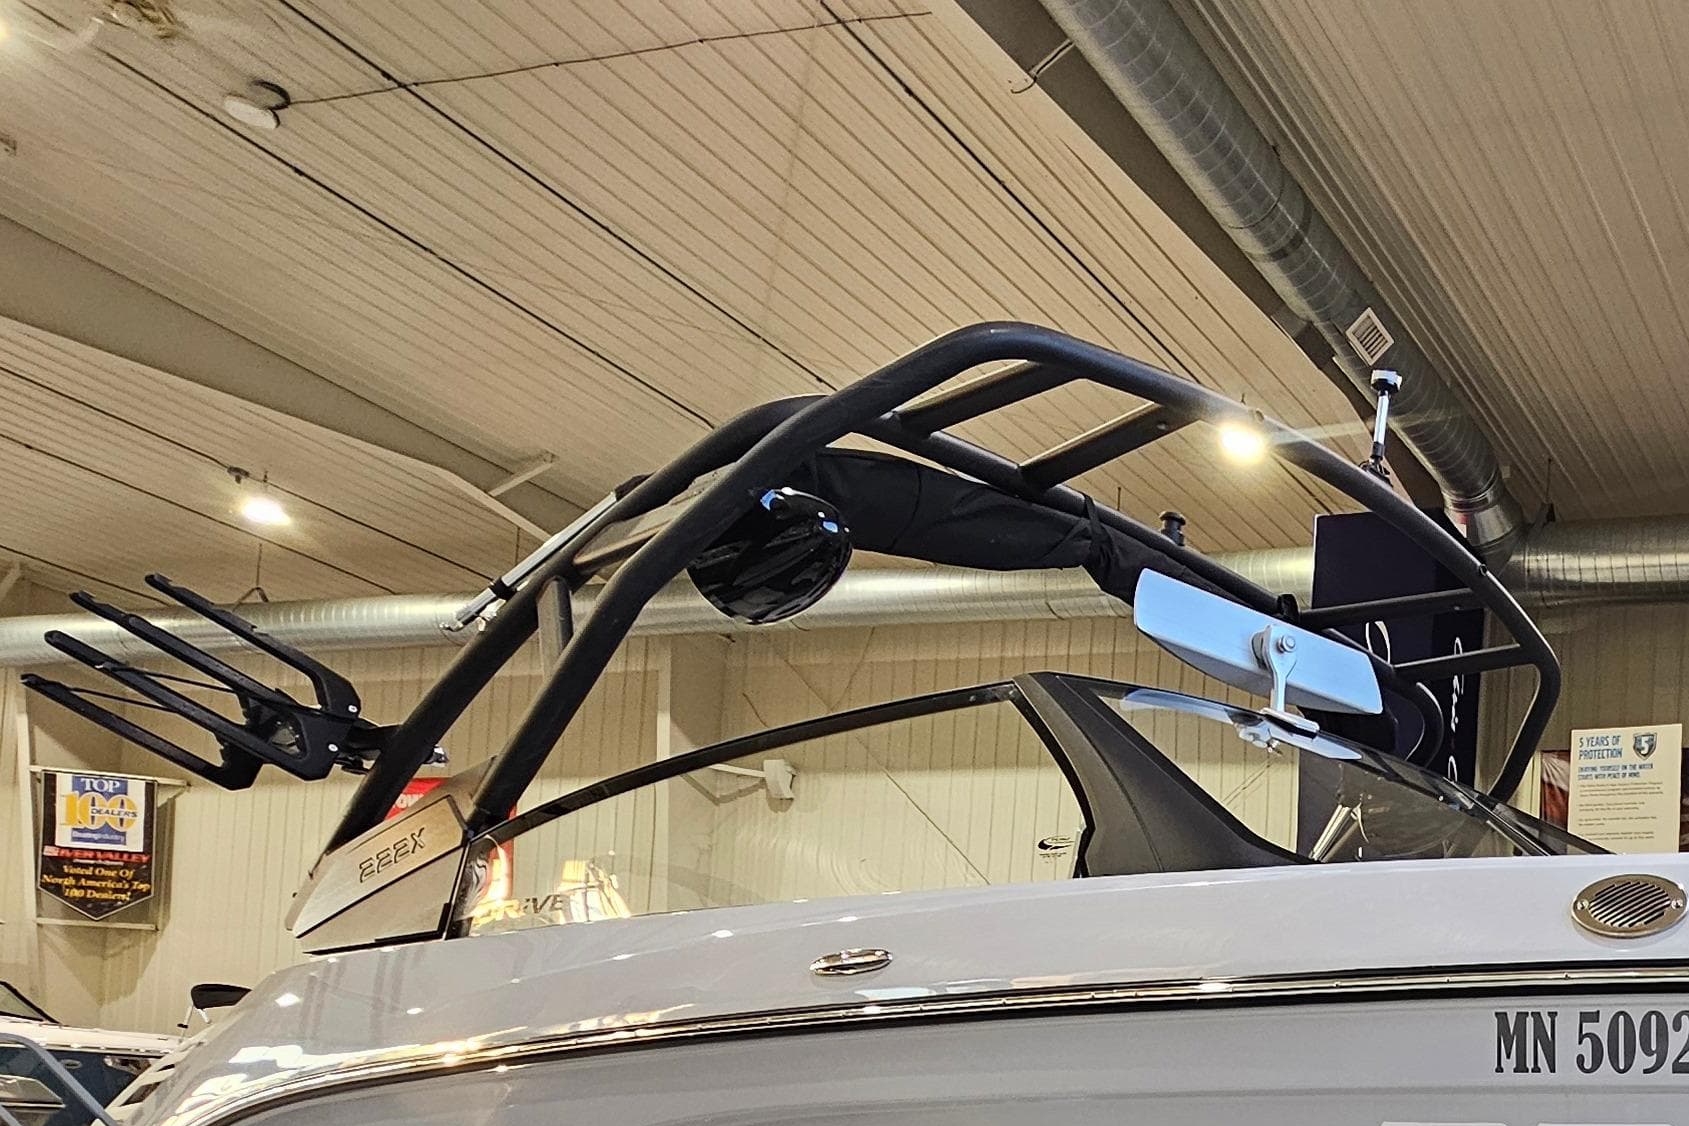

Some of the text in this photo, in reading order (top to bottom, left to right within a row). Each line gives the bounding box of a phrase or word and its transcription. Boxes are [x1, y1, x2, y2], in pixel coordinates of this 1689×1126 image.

[1586, 735, 1610, 748] YEARS
[1611, 735, 1621, 746] OF
[1579, 747, 1623, 760] PROTECTION
[81, 778, 120, 793] TOP
[60, 791, 138, 832] 100
[91, 807, 138, 818] DEALERS
[96, 849, 151, 863] VALLEY
[63, 864, 136, 880] Voted One Of
[41, 874, 151, 892] North America's Top
[1494, 1009, 1558, 1075] MN
